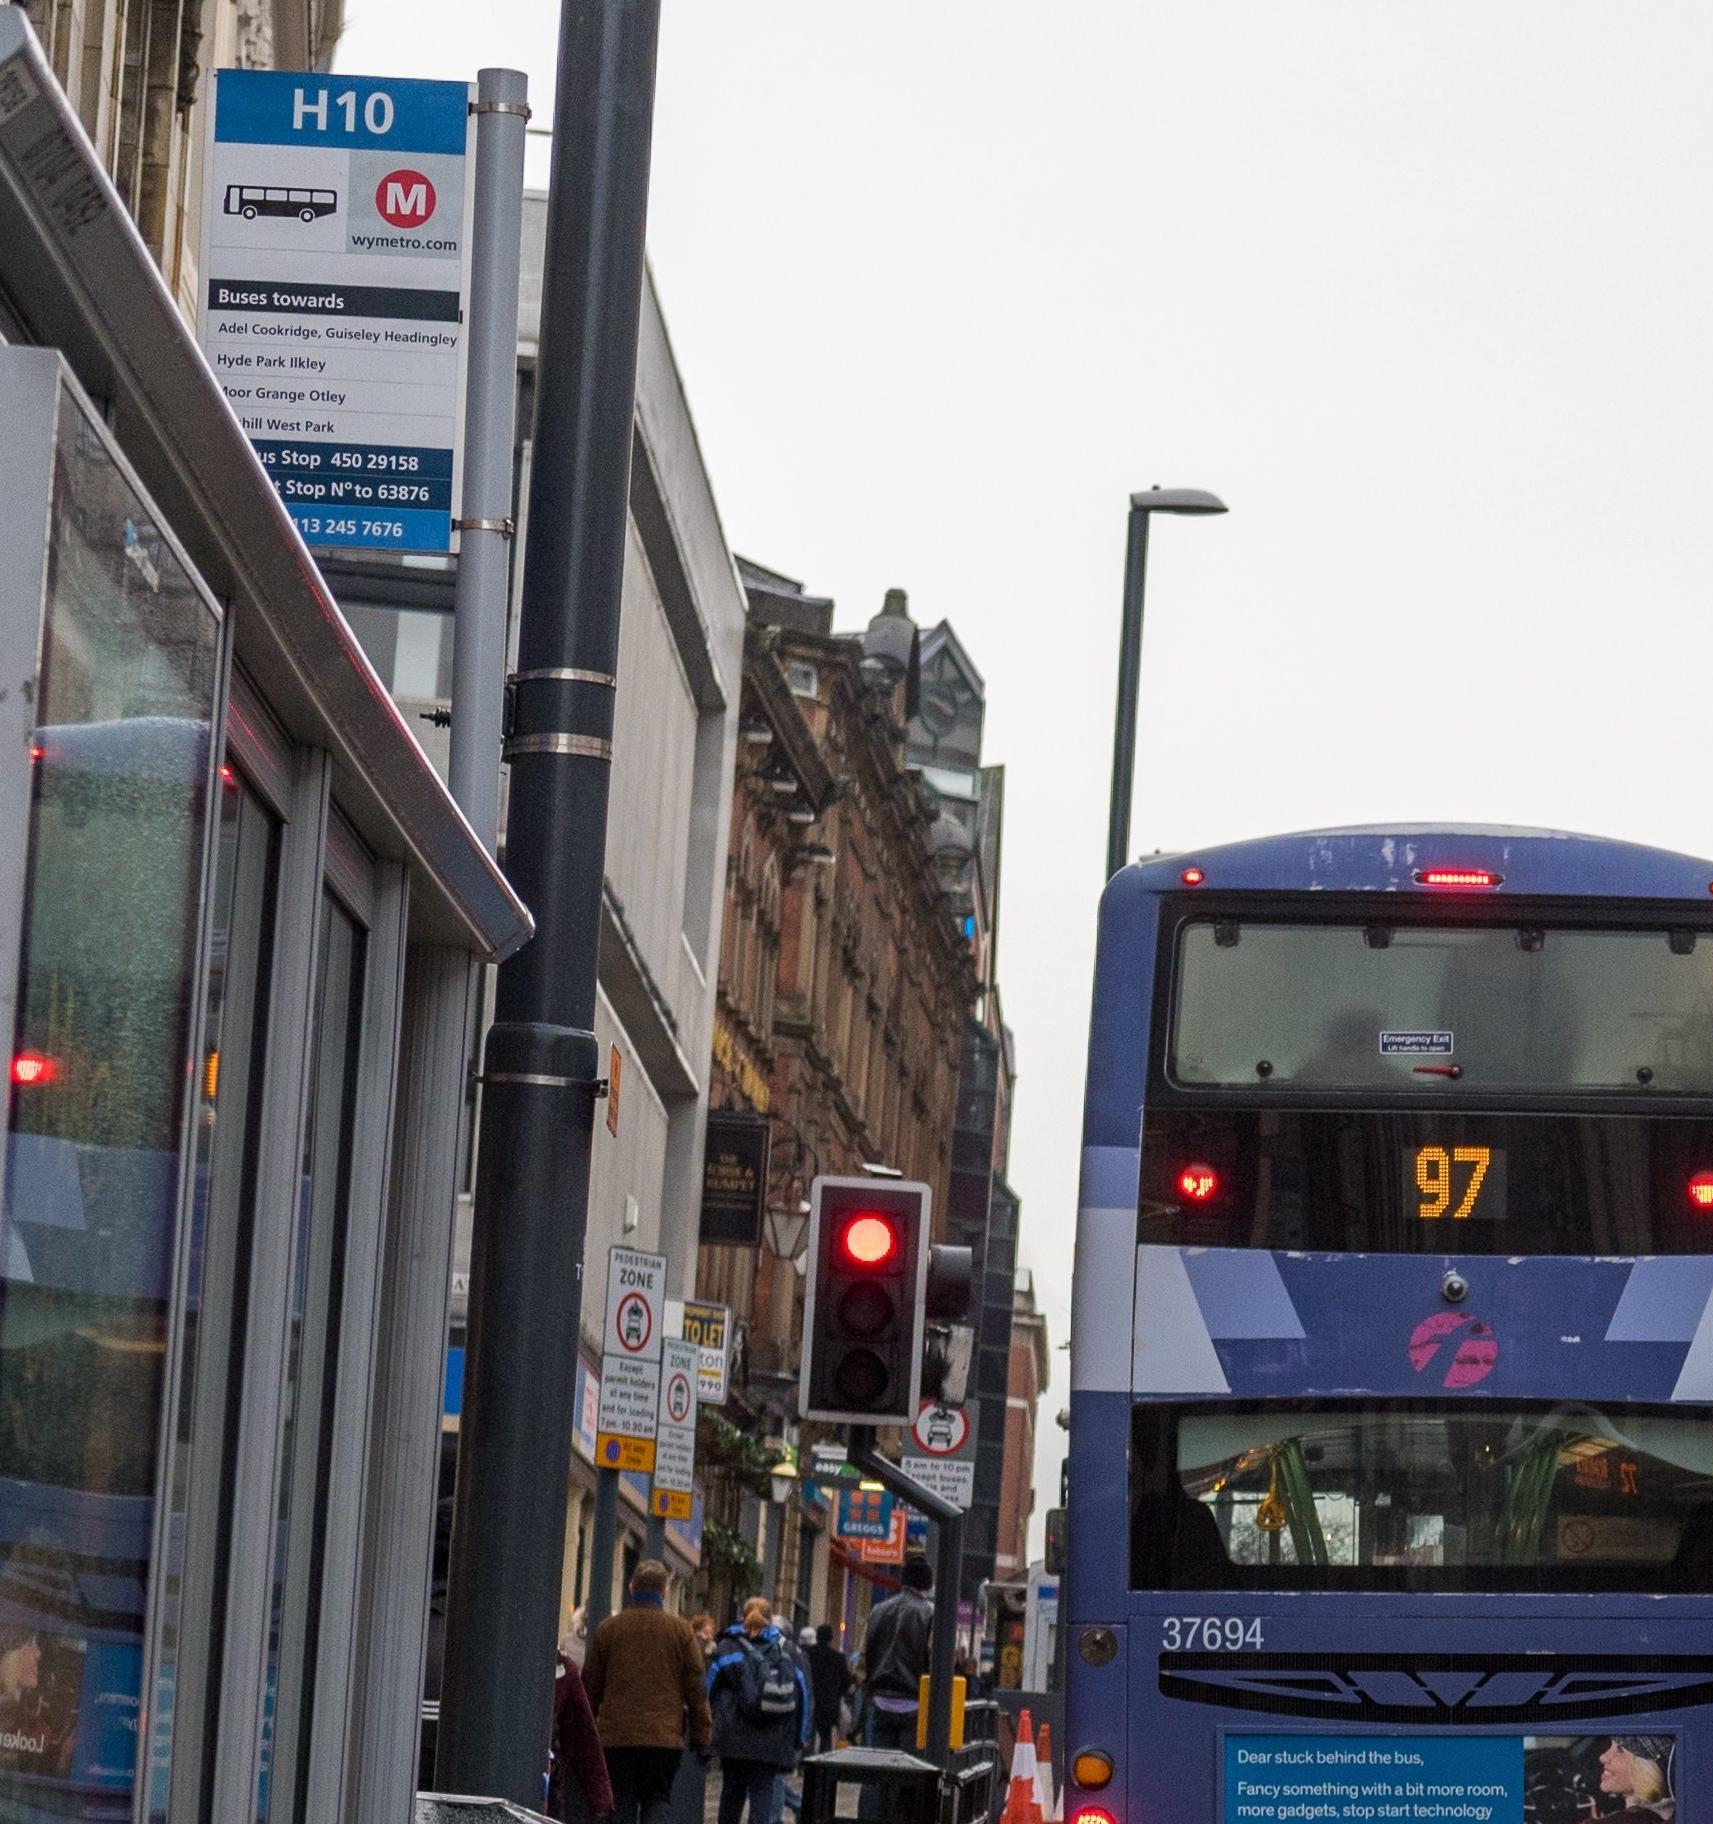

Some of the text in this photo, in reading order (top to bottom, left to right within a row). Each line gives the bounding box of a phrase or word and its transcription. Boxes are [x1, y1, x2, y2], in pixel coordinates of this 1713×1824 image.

[292, 87, 395, 134] H10
[385, 182, 428, 216] M
[352, 233, 457, 252] wymetro.com
[219, 289, 344, 309] Buses towards
[218, 322, 457, 347] Adel Cookridge, Guiseley Headingley
[217, 354, 326, 373] Hyde Park Ilkley
[256, 387, 346, 405] Grange Otley
[267, 420, 335, 433] West Park
[281, 450, 418, 471] Stop 450 29158
[286, 480, 326, 498] Stop
[355, 484, 373, 498] to
[378, 485, 429, 502] 63876
[325, 519, 403, 537] 245 7676
[1415, 1146, 1491, 1220] 97
[615, 1252, 662, 1269] PEDESTRIAN
[620, 1268, 654, 1289] ZONE
[684, 1319, 724, 1349] TO LET
[670, 1354, 691, 1371] ZONE
[843, 1521, 885, 1535] GREGGS
[1162, 1616, 1265, 1650] 37694
[1237, 1750, 1424, 1766] Dear stuck behind the bus,
[1237, 1781, 1508, 1799] Fancy something with a bit more room,
[1237, 1803, 1493, 1820] more gadgets, stop start technology
